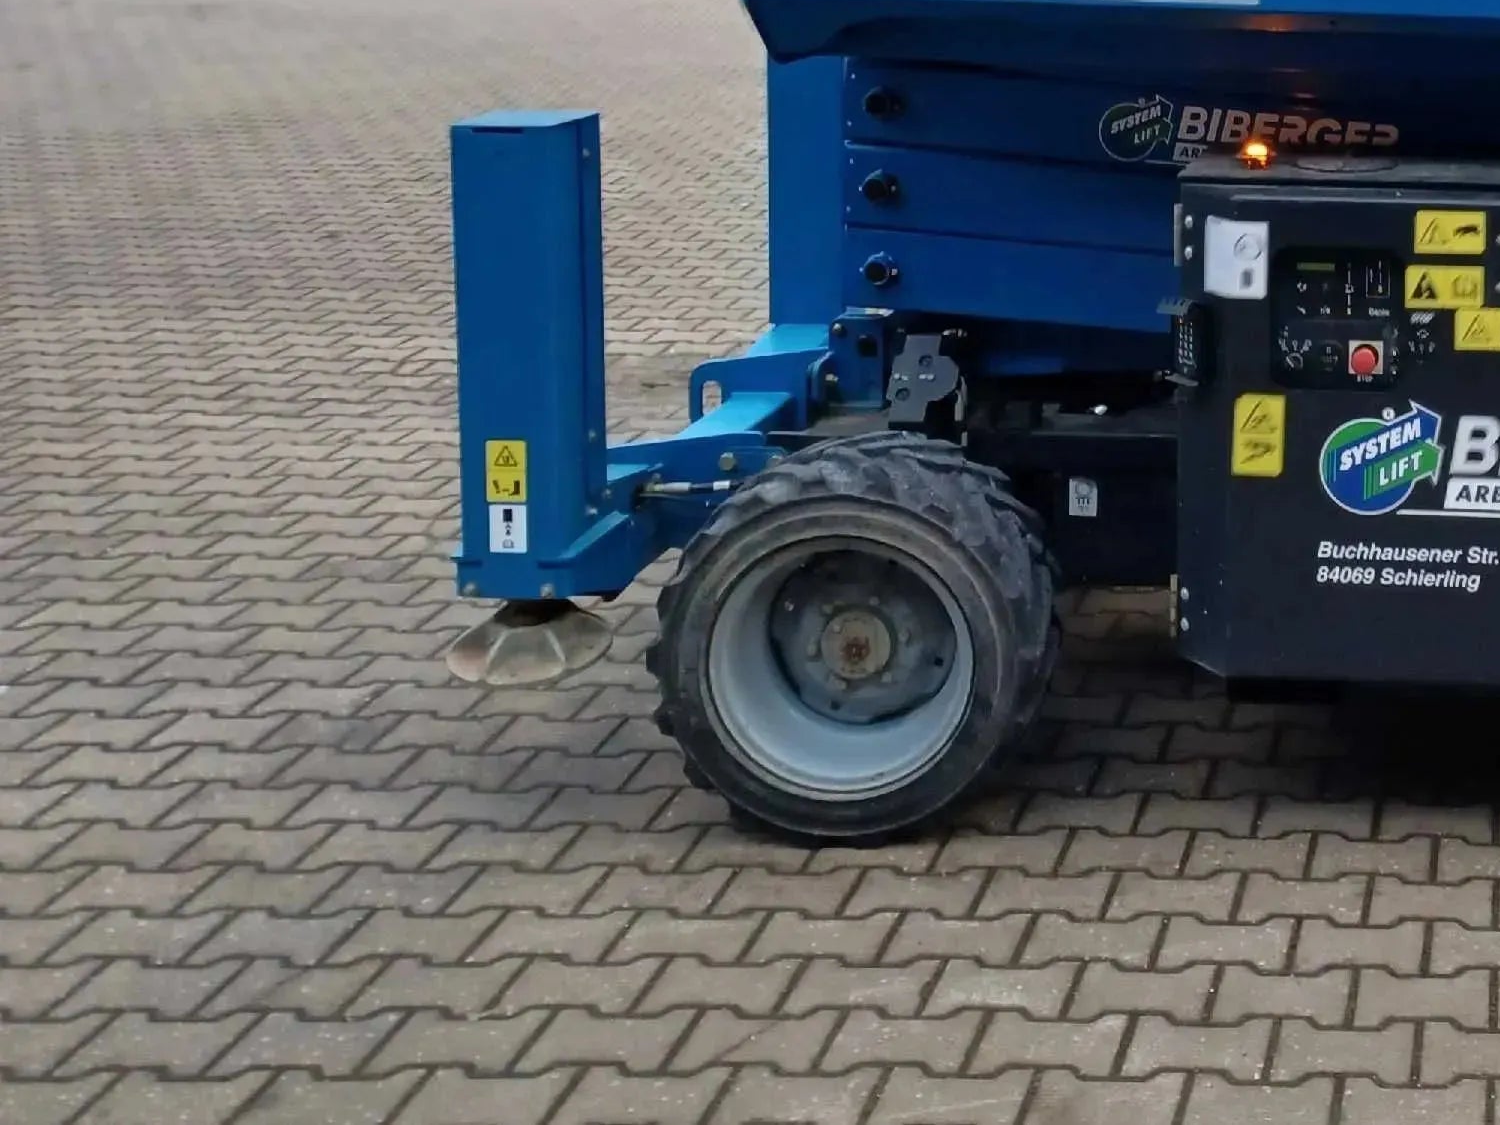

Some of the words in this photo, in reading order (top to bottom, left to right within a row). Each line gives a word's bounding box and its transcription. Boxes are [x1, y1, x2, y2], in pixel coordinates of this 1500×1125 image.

[1111, 105, 1161, 134] SYSTEM
[1134, 124, 1160, 144] LIFT
[1339, 418, 1421, 471] SYSTEM
[1379, 451, 1422, 486] LIFT
[1317, 541, 1462, 564] Buchhausener
[1466, 546, 1499, 565] Str.
[1316, 565, 1376, 585] 84069
[1380, 567, 1481, 593] Schierling
